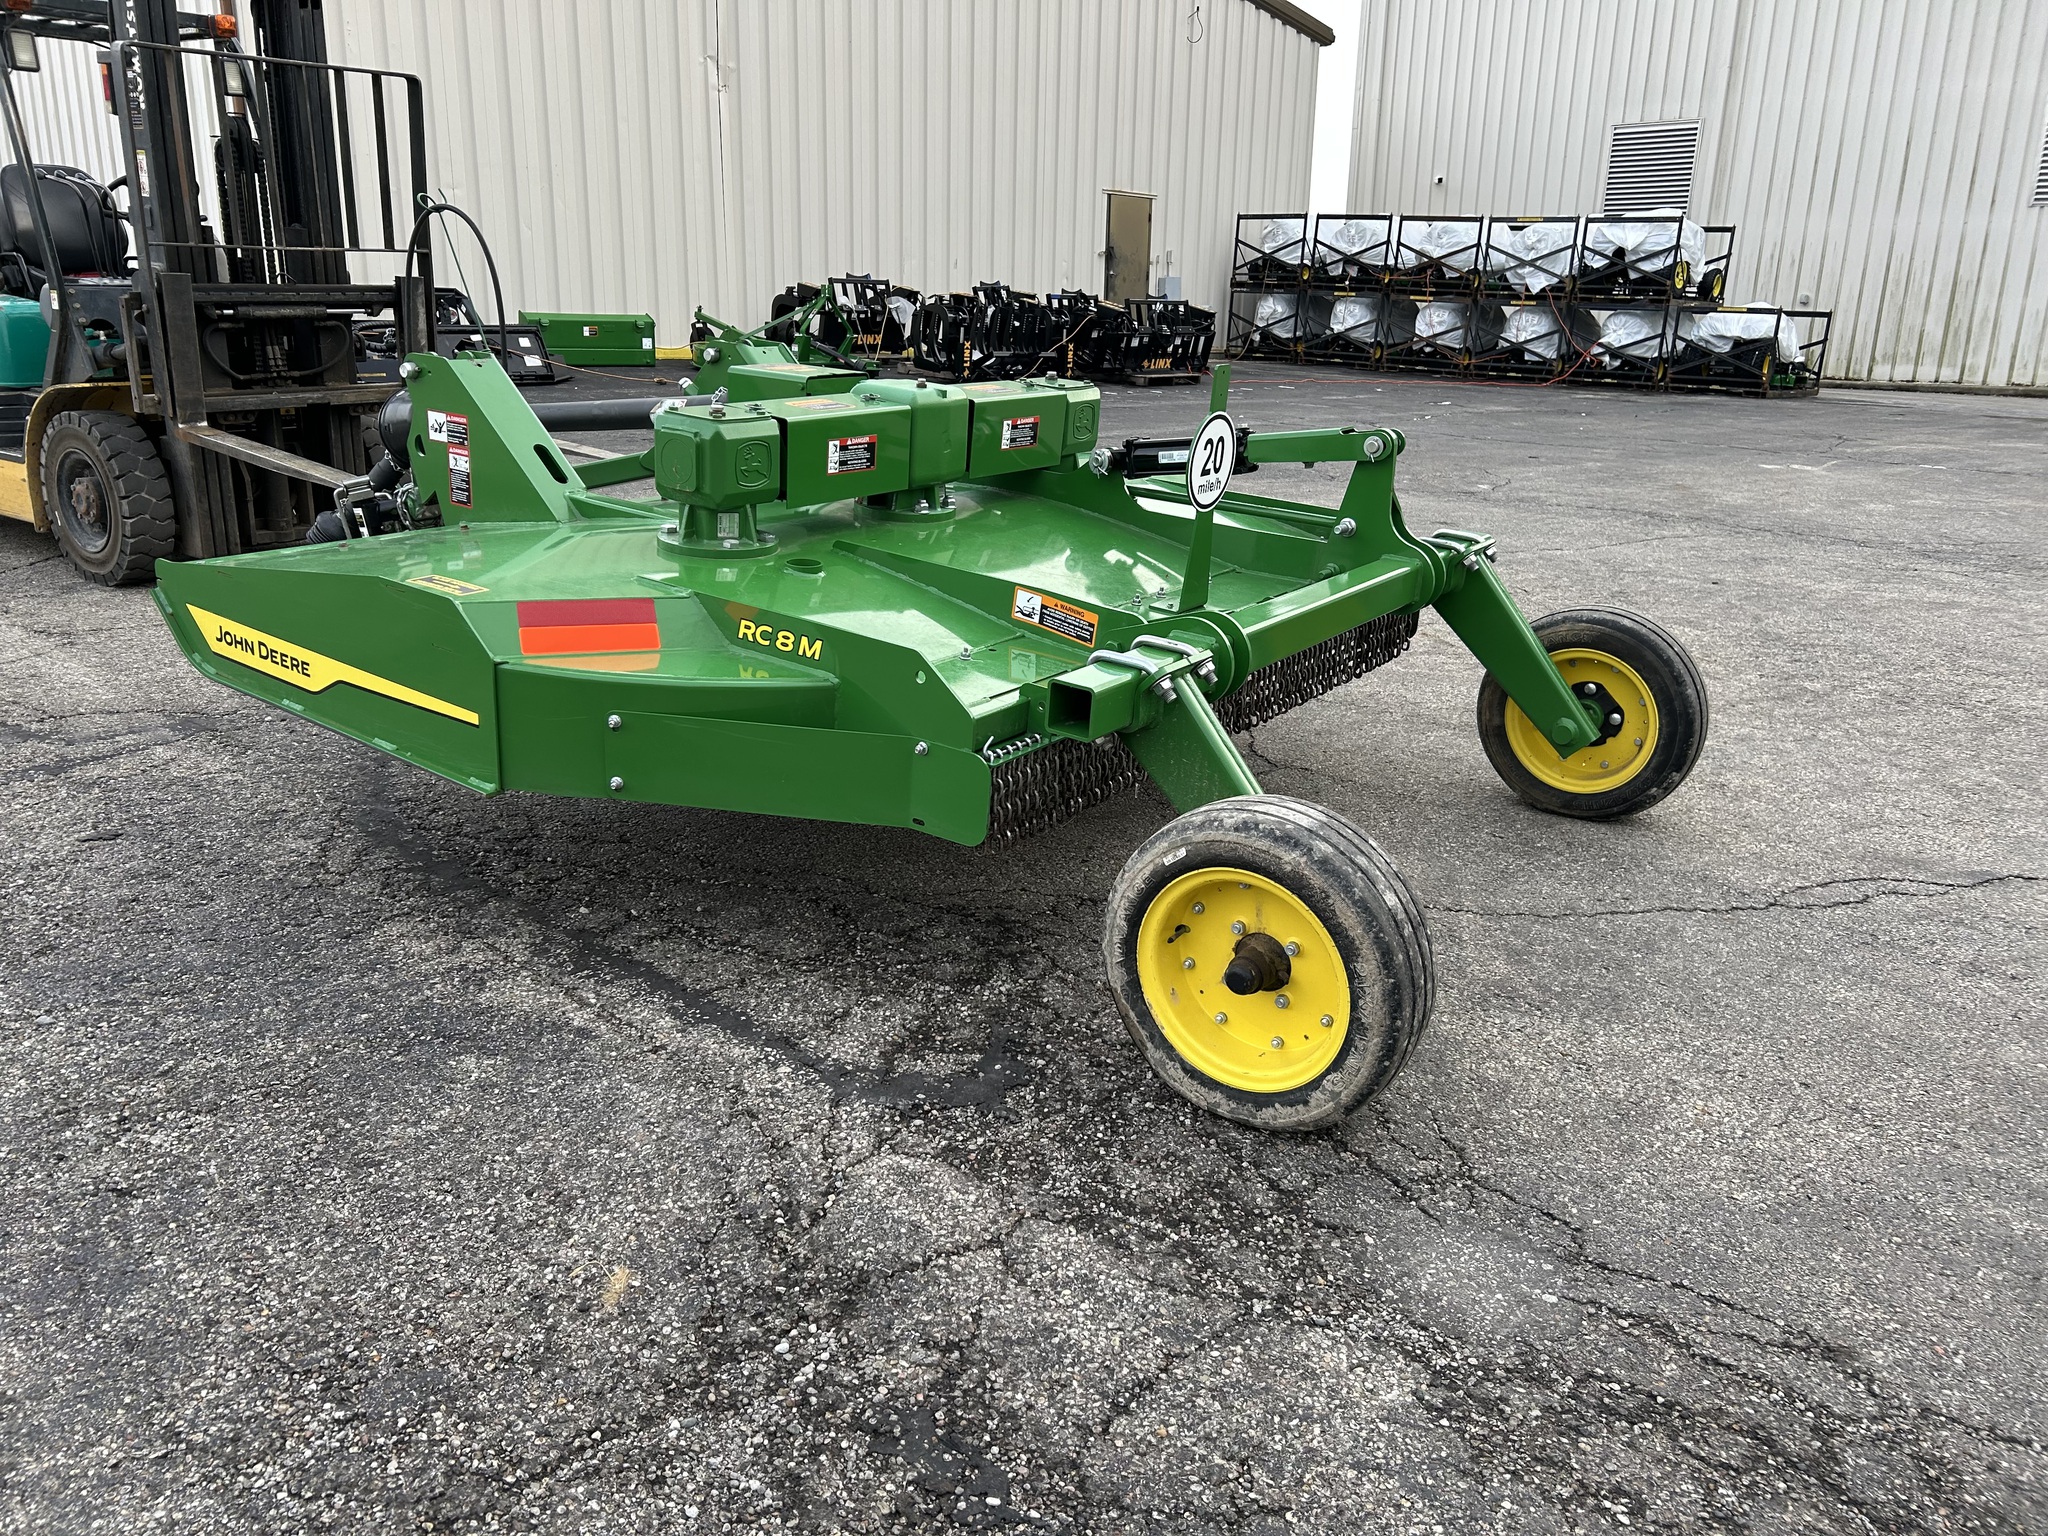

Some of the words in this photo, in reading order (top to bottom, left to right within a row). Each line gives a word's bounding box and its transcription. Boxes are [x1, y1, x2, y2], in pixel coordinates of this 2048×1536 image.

[857, 334, 881, 345] LINX
[1150, 358, 1172, 369] LINX
[851, 436, 870, 444] DANGER
[1200, 435, 1225, 477] 20
[1197, 477, 1222, 495] mile/h
[1060, 603, 1085, 618] WARNING
[216, 625, 255, 656] JOHN
[258, 640, 311, 678] DEERE
